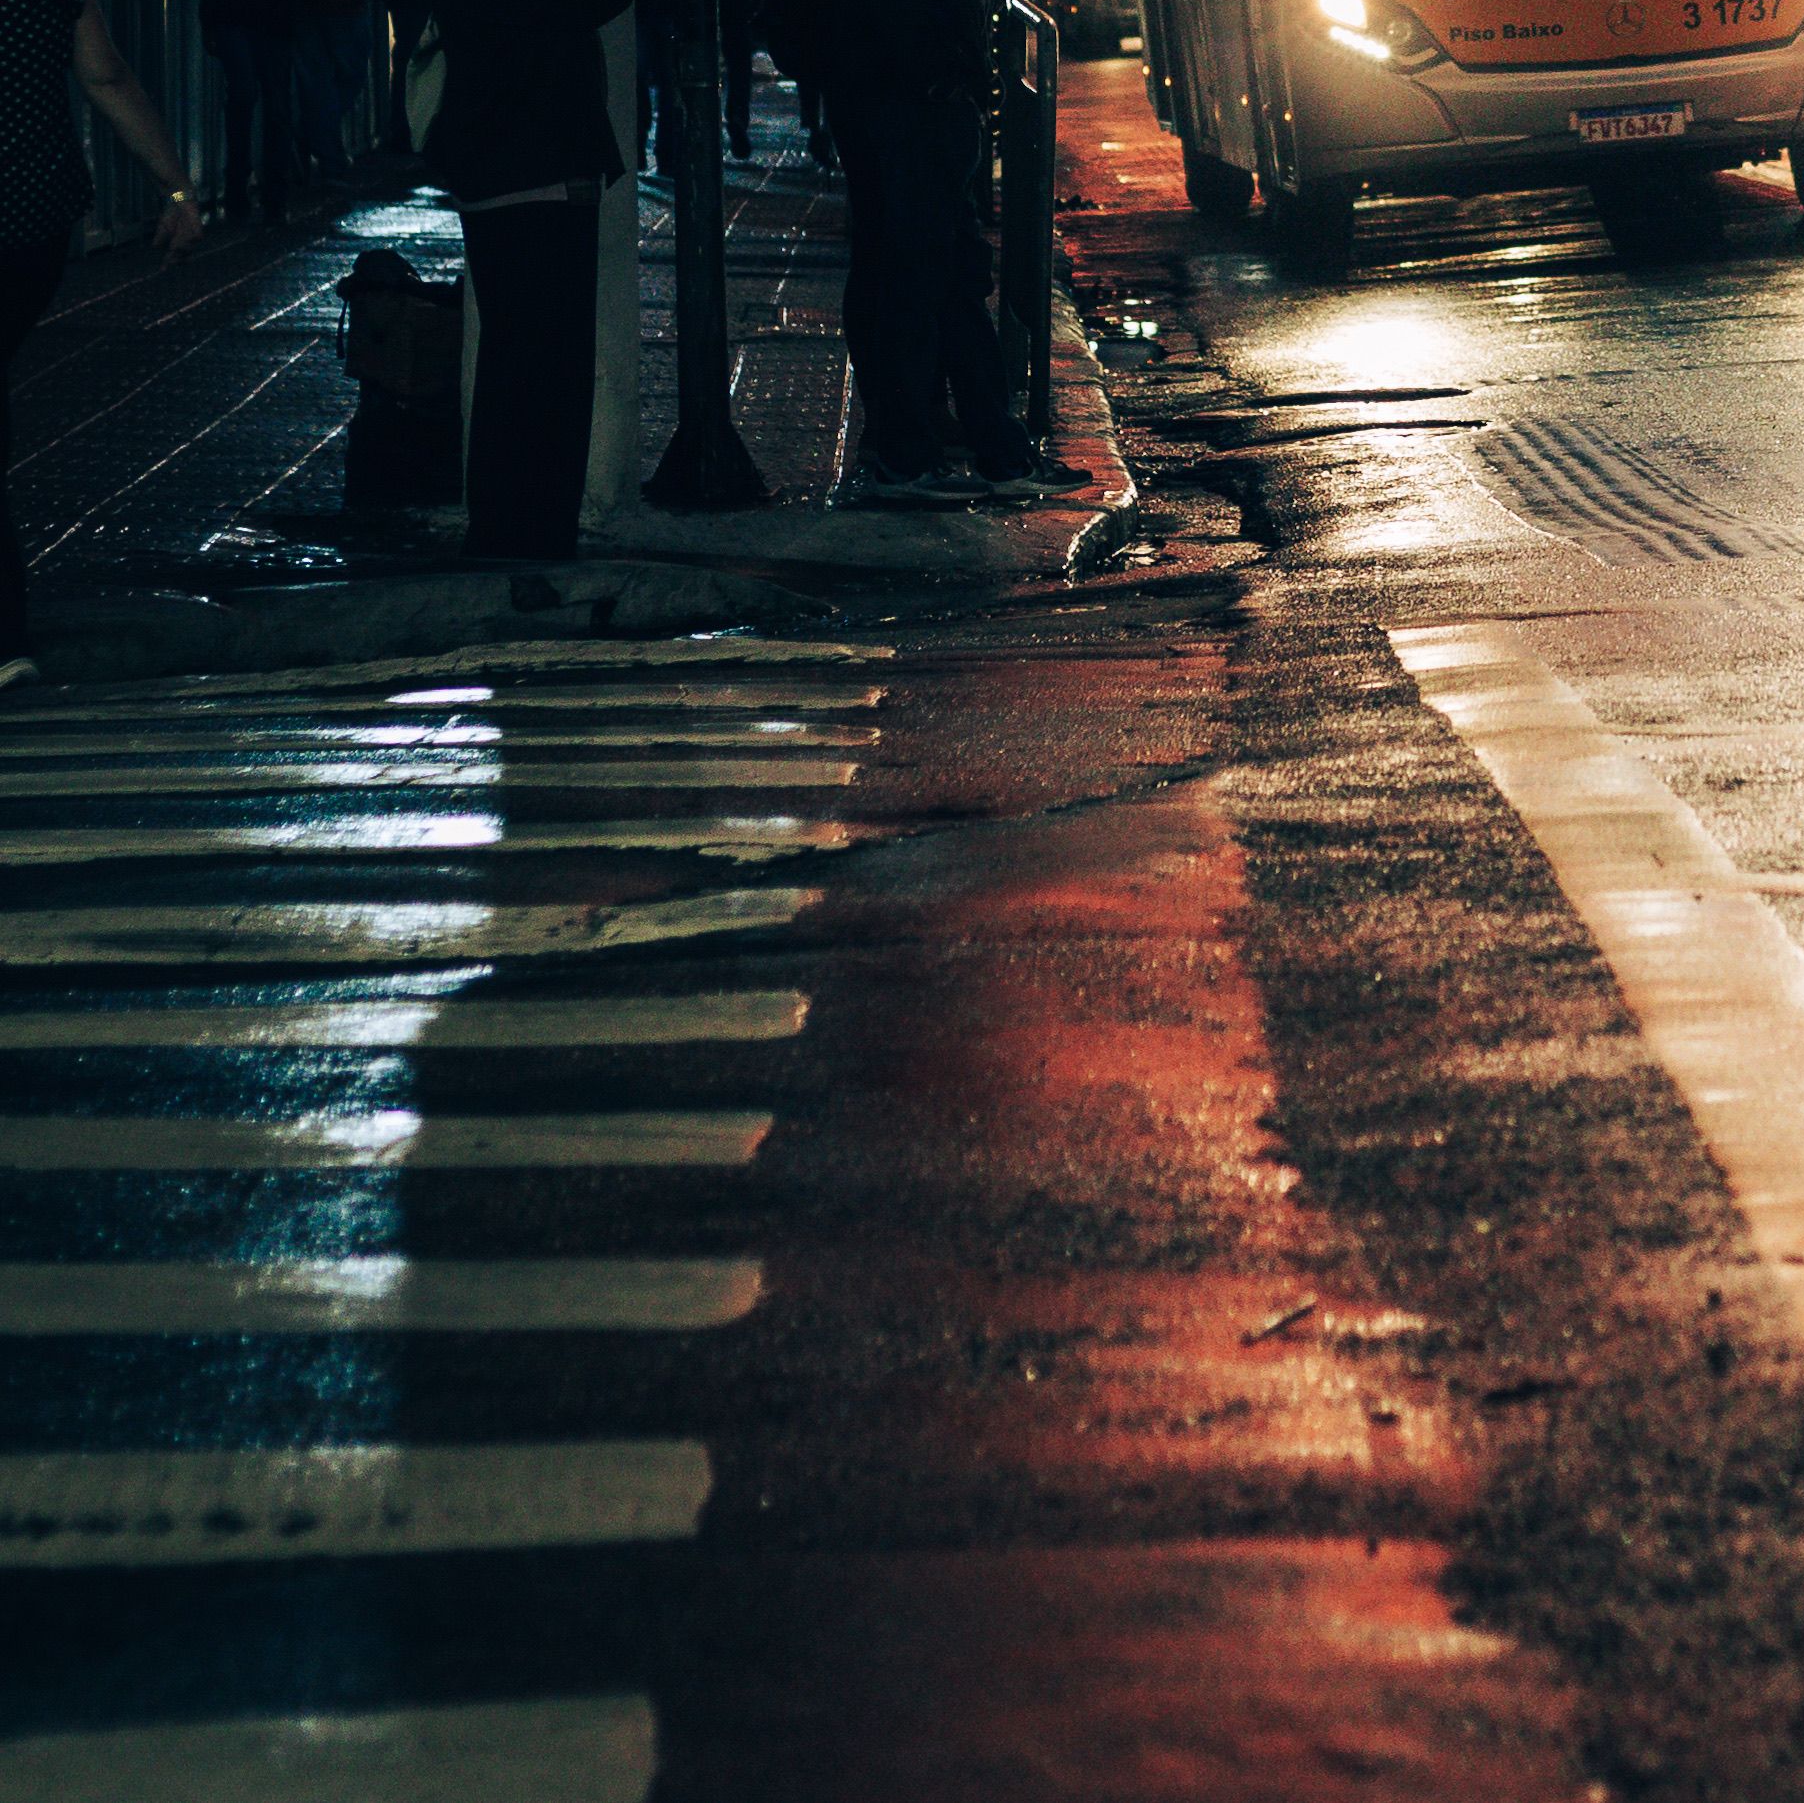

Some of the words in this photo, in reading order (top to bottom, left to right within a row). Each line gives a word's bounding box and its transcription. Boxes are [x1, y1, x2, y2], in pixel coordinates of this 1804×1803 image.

[1682, 2, 1700, 31] 3
[1449, 24, 1496, 43] Piso
[1502, 22, 1565, 41] Baixo
